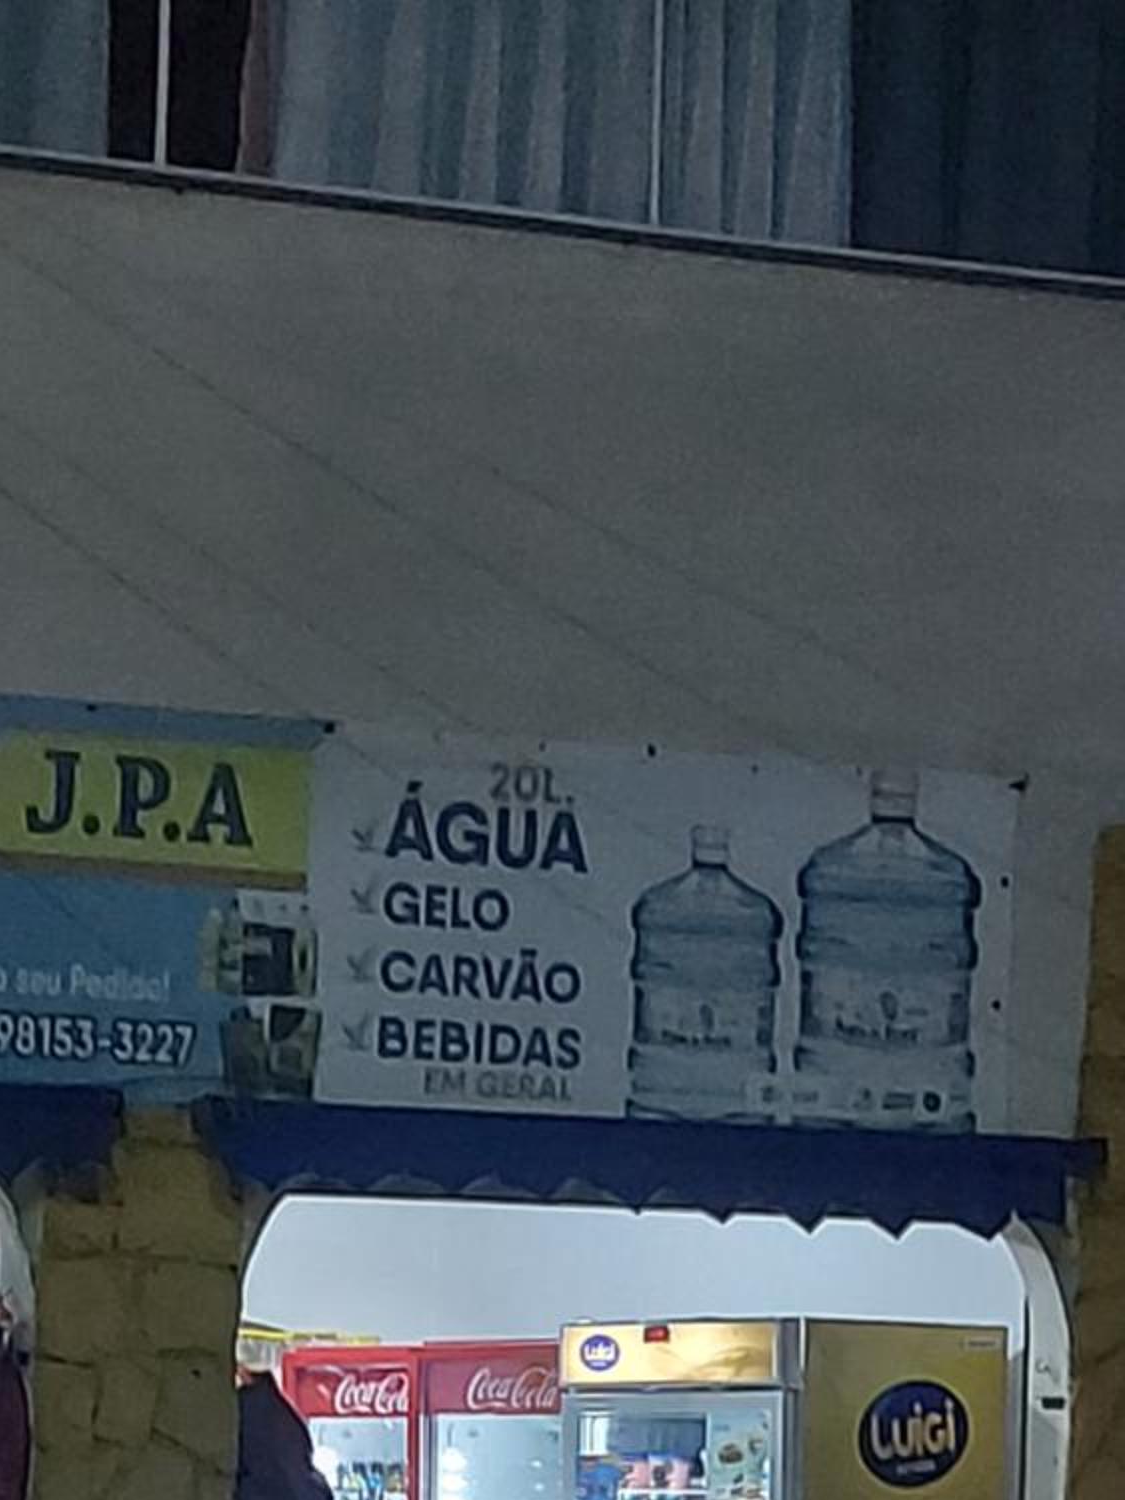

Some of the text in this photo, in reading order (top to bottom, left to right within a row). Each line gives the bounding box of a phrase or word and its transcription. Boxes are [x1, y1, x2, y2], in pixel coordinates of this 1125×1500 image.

[24, 749, 254, 848] J.P.A
[384, 779, 588, 875] ÁGUA
[383, 881, 510, 932] GELO
[15, 970, 63, 997] seu
[380, 947, 582, 1004] CARVÃO
[377, 1016, 582, 1070] BEBIDAS
[424, 1069, 573, 1102] EM GERAL
